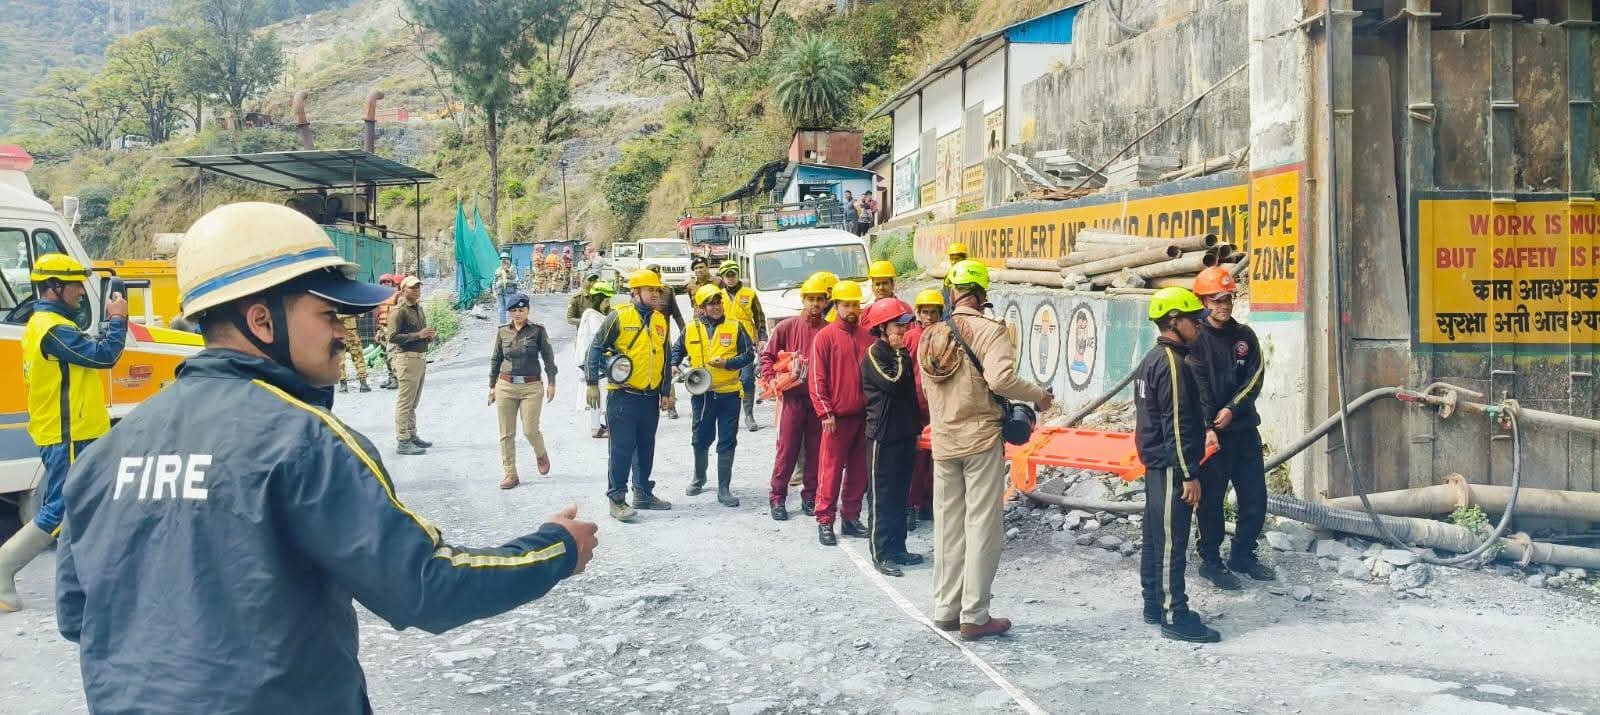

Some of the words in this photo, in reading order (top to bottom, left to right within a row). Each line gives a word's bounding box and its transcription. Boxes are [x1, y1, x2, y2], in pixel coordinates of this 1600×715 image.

[1257, 196, 1293, 237] PPE
[1469, 214, 1536, 236] WORK
[1545, 214, 1561, 235] IS
[1000, 227, 1013, 258] BE
[1016, 223, 1055, 259] ALERT
[1436, 247, 1476, 269] BUT
[1570, 246, 1586, 266] IS
[1253, 244, 1295, 281] ZONE
[113, 453, 212, 500] FIRE
